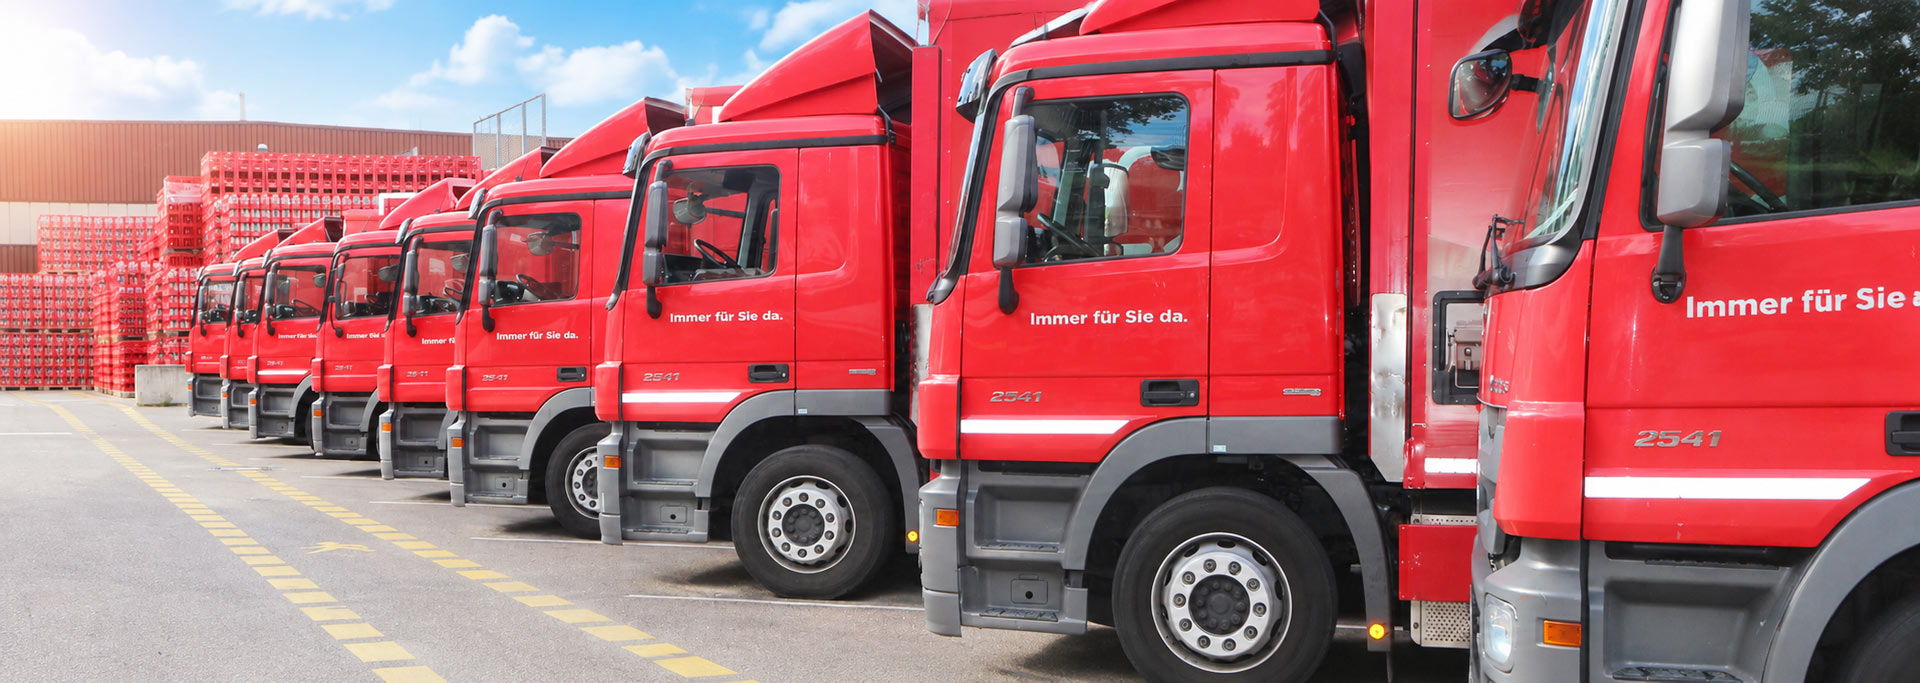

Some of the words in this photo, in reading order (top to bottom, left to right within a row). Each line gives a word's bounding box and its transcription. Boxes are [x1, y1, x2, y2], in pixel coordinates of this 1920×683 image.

[1686, 296, 1793, 318] Immer
[1801, 289, 1848, 313] für
[1855, 286, 1907, 310] Sie
[670, 312, 712, 323] Immer
[714, 311, 735, 322] für
[737, 310, 759, 321] Sie
[762, 310, 784, 321] da.
[1030, 312, 1088, 325] Immer
[1092, 310, 1121, 324] für
[1125, 309, 1154, 323] Sie
[1159, 308, 1189, 323] da.
[496, 332, 528, 340] Immer
[528, 331, 544, 340] für
[546, 331, 561, 340] Sie
[563, 330, 579, 339] da.
[643, 372, 680, 382] 2541
[989, 391, 1042, 403] 2541
[1634, 430, 1722, 447] 2541
